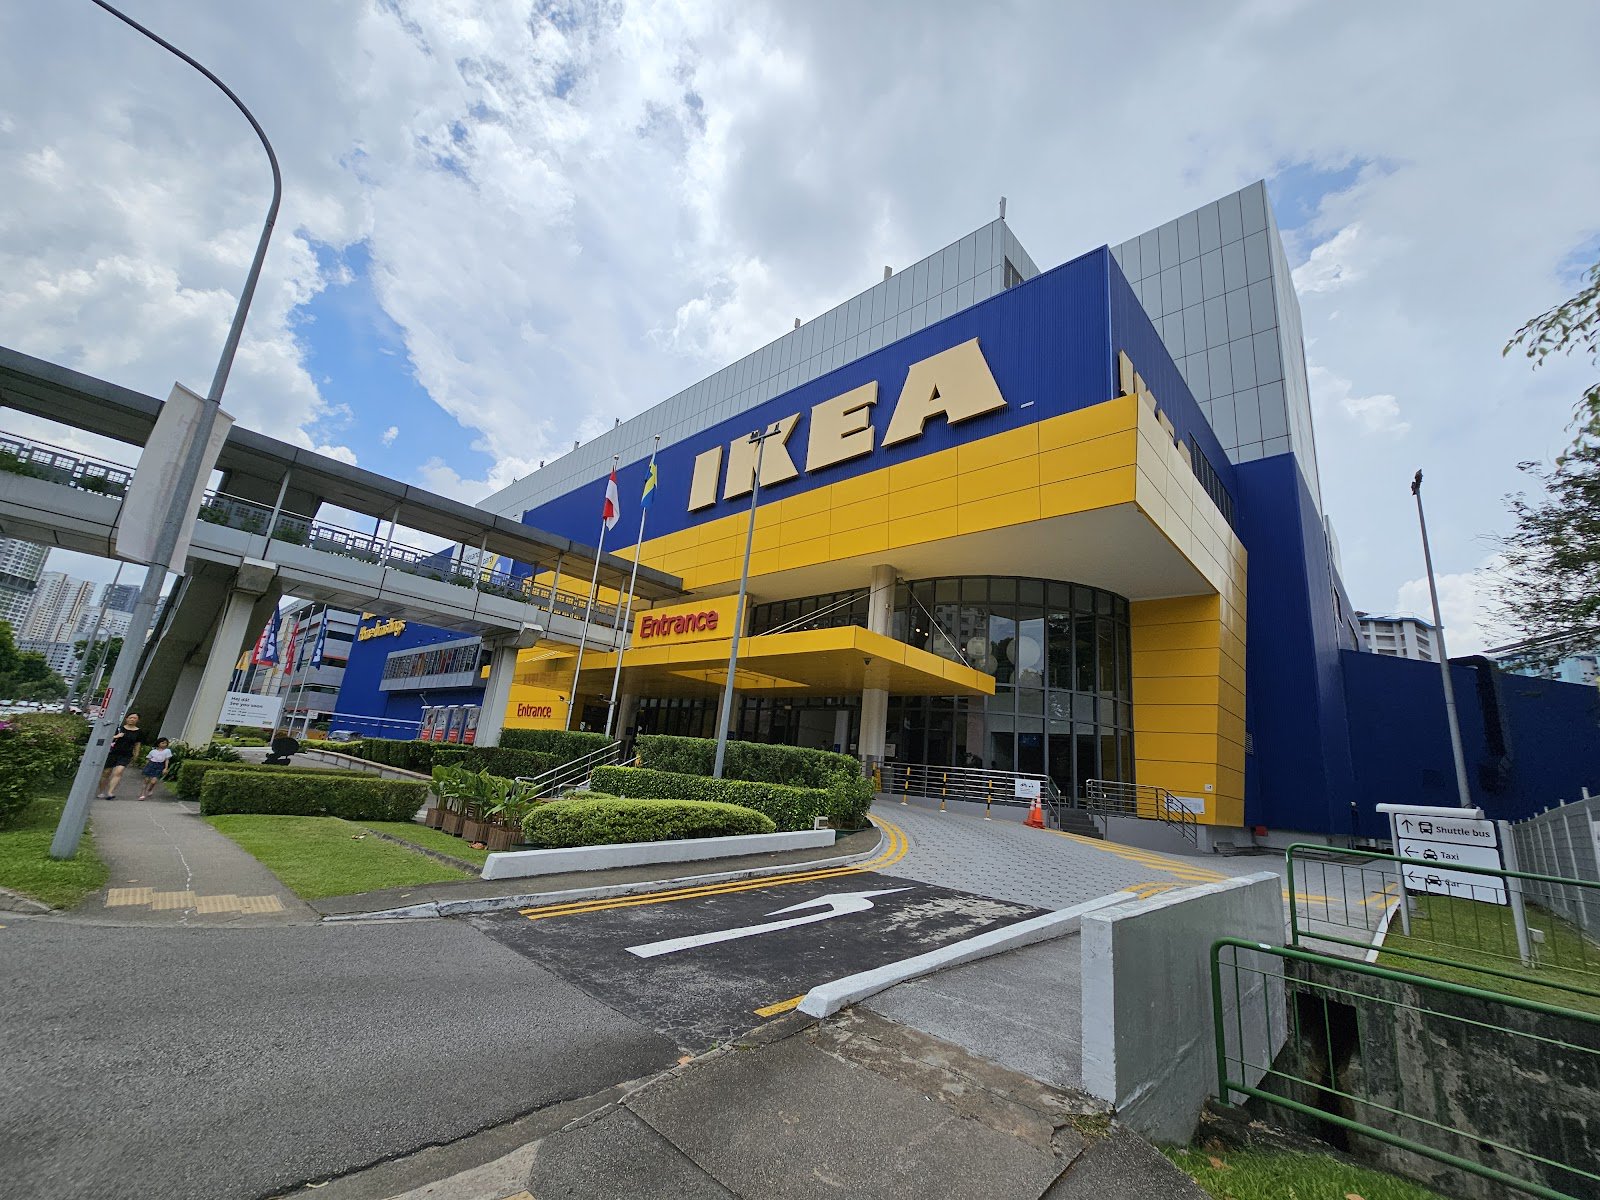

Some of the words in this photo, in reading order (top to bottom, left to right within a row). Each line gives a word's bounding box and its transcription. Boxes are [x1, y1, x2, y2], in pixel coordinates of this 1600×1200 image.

[687, 336, 1009, 512] IKEA
[640, 610, 719, 639] Entrance
[517, 703, 552, 718] Entrance
[1436, 826, 1470, 837] Shuttle
[1472, 829, 1491, 838] bus
[1440, 851, 1460, 861] Taxi
